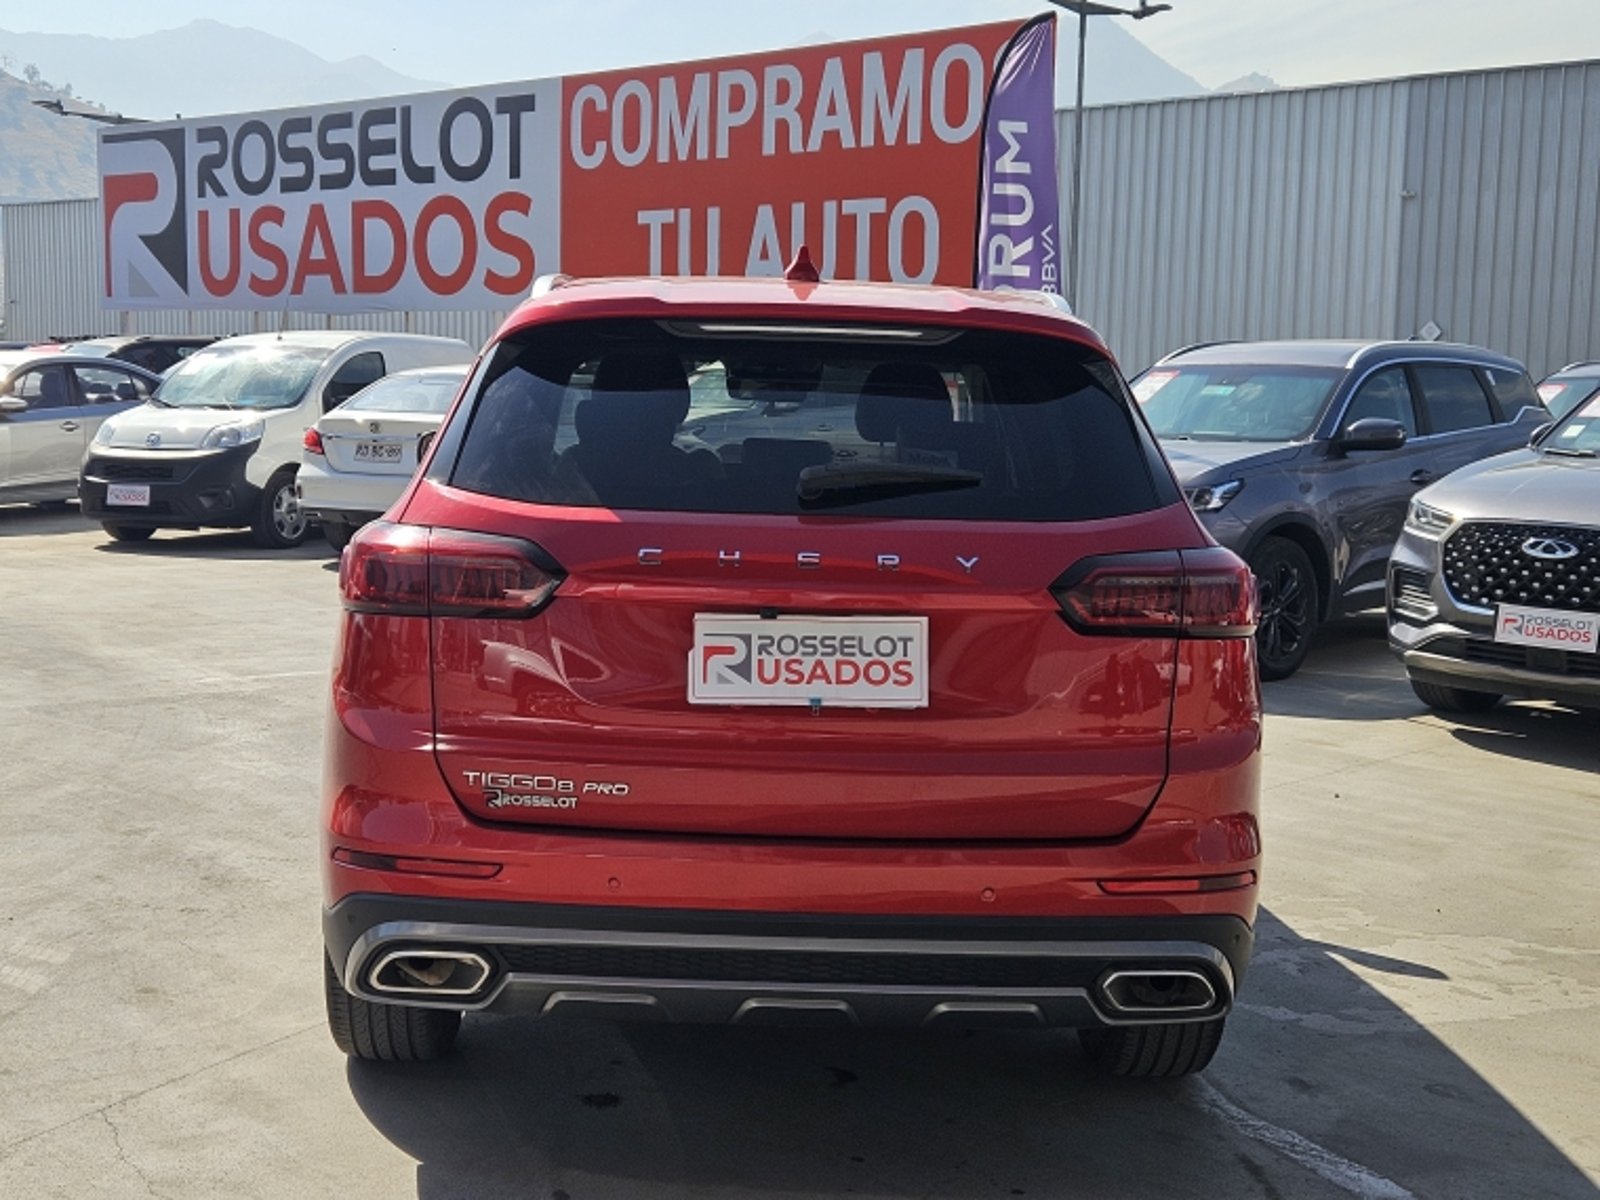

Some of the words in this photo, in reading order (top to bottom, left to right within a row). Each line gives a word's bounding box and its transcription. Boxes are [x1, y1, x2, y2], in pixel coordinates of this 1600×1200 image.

[569, 39, 1008, 170] COMPRAMO
[197, 94, 536, 198] ROSSELOT
[987, 120, 1035, 292] RUM
[198, 191, 536, 298] USADOS
[637, 205, 720, 280] TU
[745, 195, 940, 285] AUTO
[637, 548, 979, 573] CHERY
[757, 634, 914, 658] ROSSELOT
[1524, 624, 1593, 643] USADOS
[757, 658, 914, 687] USADOS
[502, 792, 578, 809] ROSSELOT
[582, 781, 630, 795] PRO
